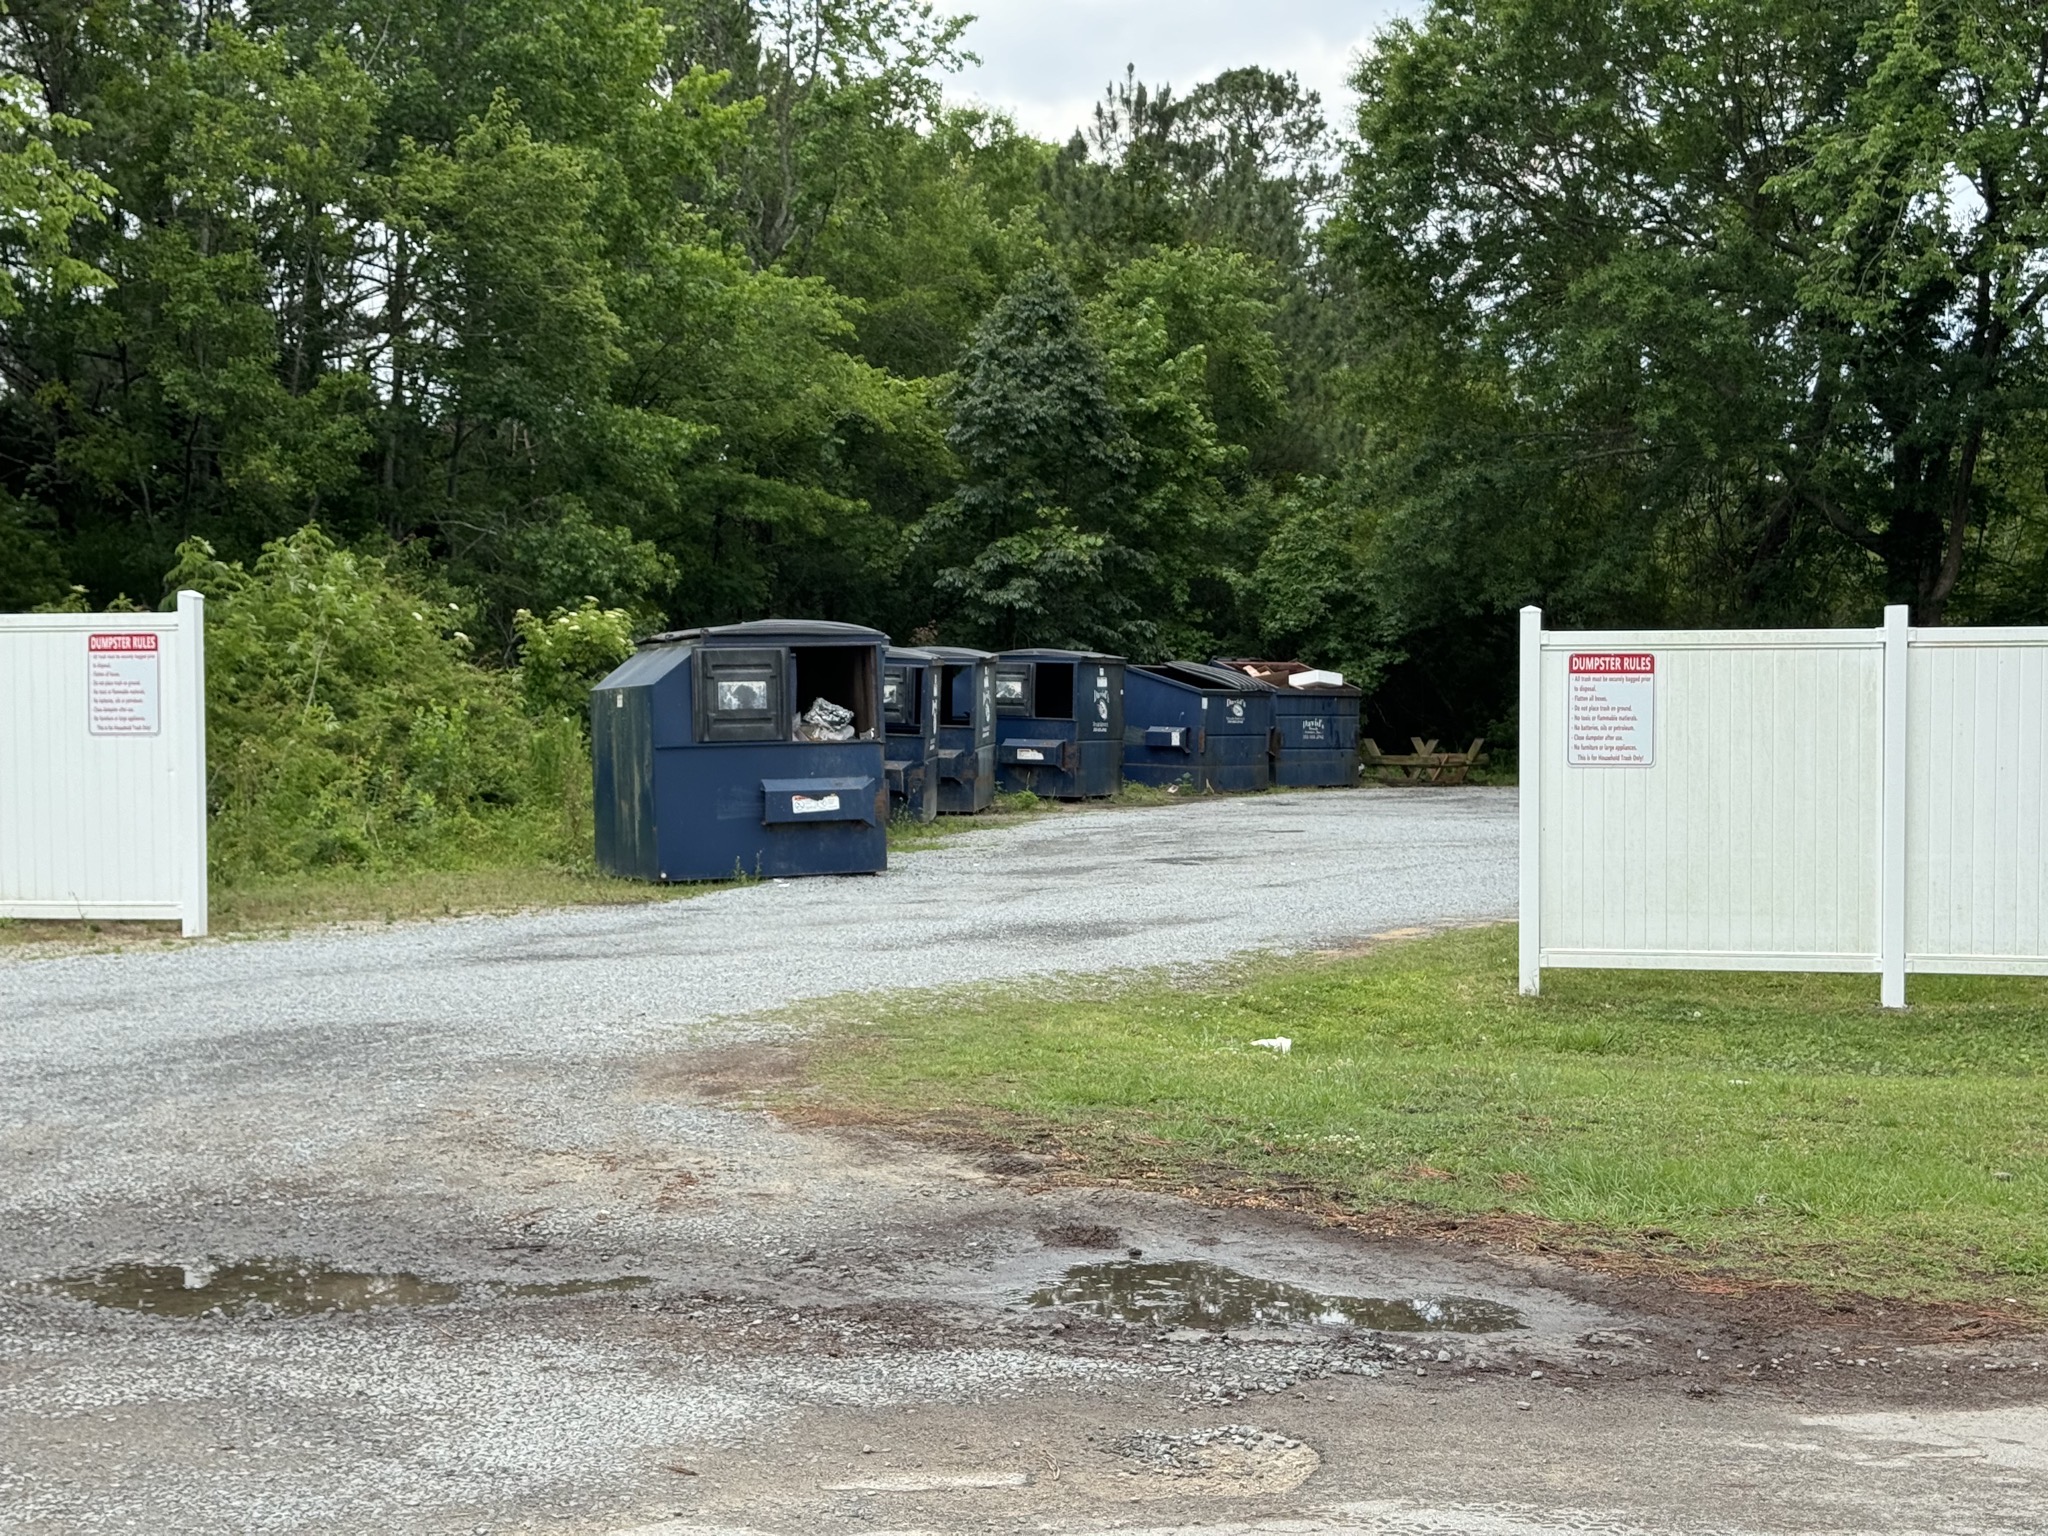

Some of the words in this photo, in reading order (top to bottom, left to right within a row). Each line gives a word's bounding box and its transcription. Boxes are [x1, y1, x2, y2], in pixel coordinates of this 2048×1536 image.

[91, 636, 131, 649] DUMPSTER
[132, 636, 156, 649] RULES
[1572, 657, 1622, 671] DUMPSTER
[1623, 657, 1651, 671] RULES
